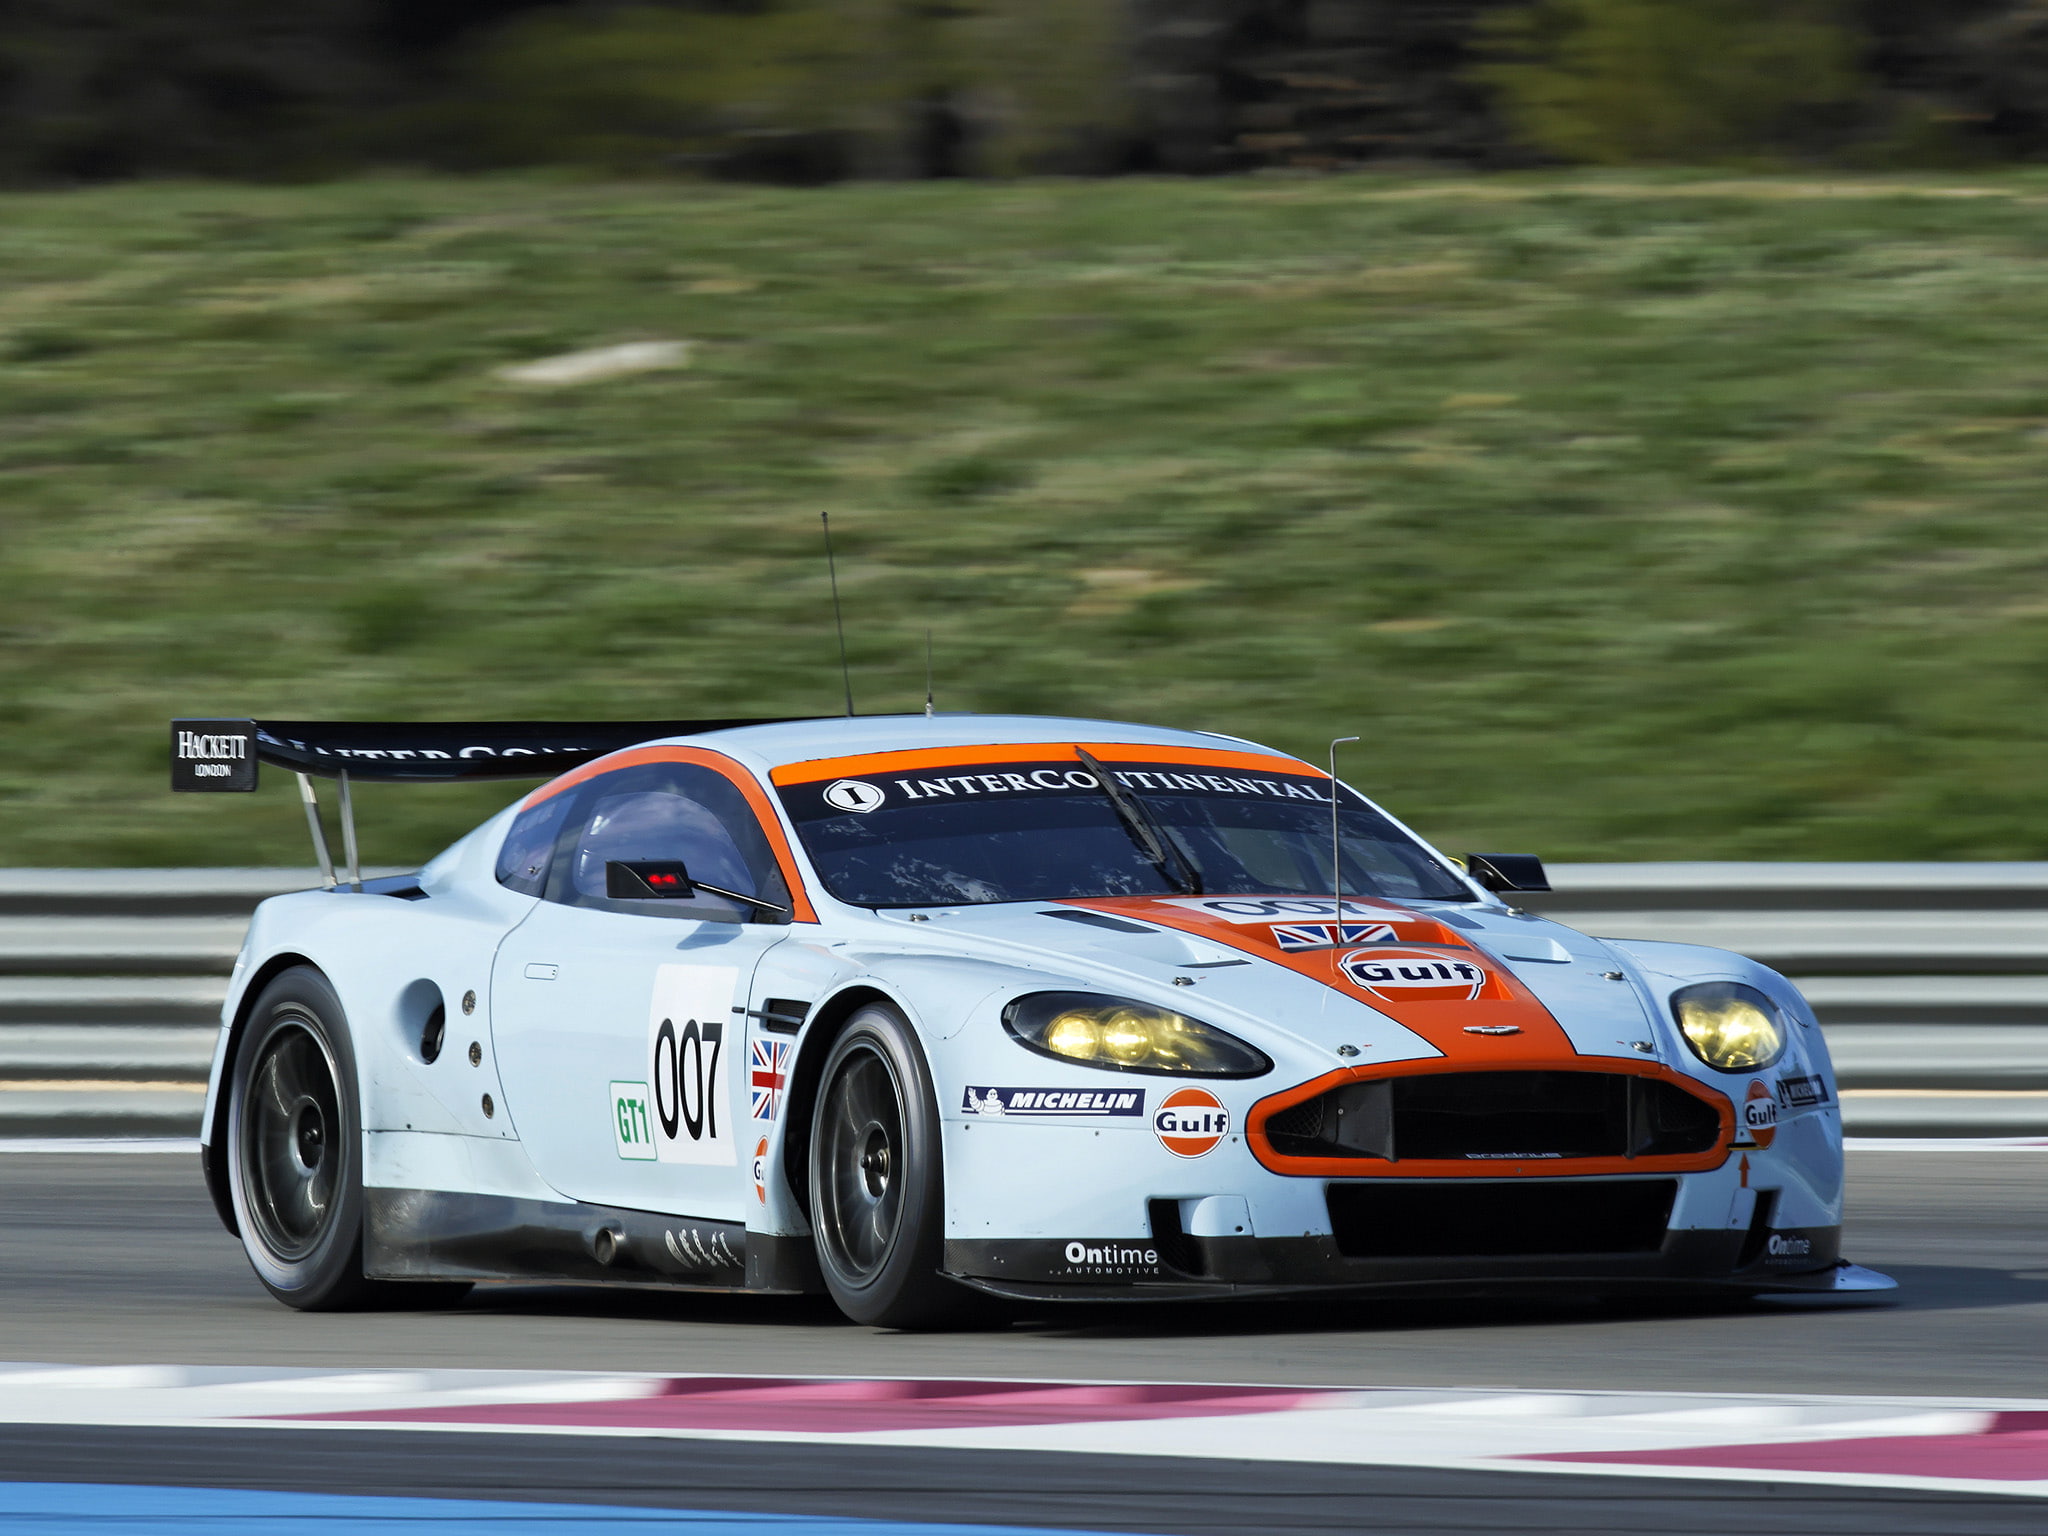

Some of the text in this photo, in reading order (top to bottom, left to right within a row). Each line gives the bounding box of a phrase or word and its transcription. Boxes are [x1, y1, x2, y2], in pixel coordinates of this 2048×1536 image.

[178, 731, 247, 759] HACKETT
[194, 764, 231, 777] LONDON
[1351, 961, 1476, 982] Gulf
[654, 1017, 723, 1141] 007
[1008, 1092, 1138, 1110] MICHELIN
[617, 1096, 650, 1144] GT1
[1156, 1112, 1227, 1133] Gulf
[1746, 1103, 1777, 1125] Gulf
[1065, 1241, 1159, 1265] Ontime
[1065, 1266, 1160, 1275] AUTOMOTIVE
